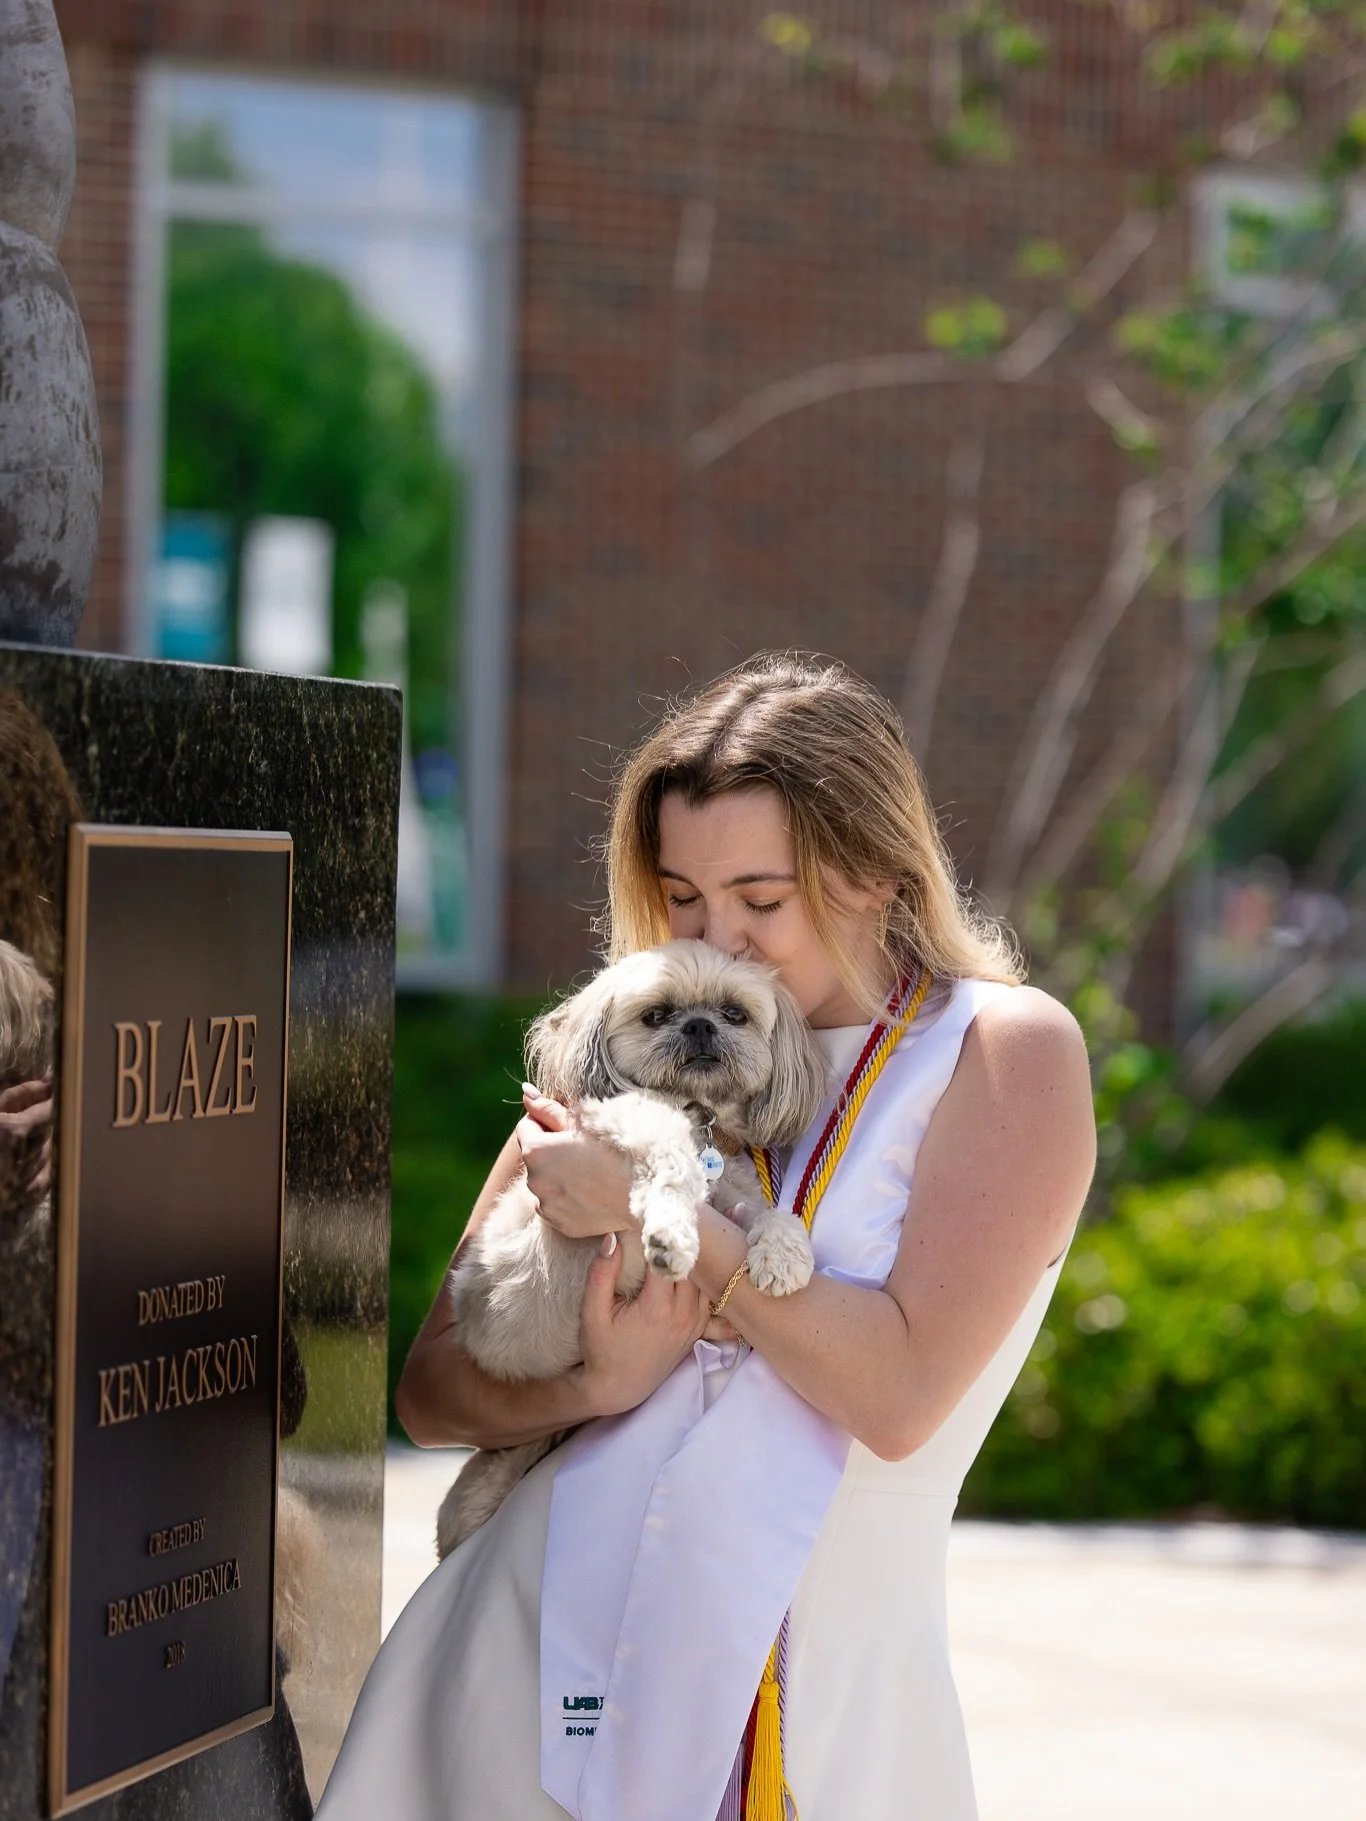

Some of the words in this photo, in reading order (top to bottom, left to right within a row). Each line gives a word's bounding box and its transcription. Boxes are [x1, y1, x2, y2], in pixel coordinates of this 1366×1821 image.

[112, 1014, 258, 1128] BLAZE
[137, 1279, 205, 1326] DONATED
[206, 1275, 226, 1312] BY
[98, 1359, 150, 1427] KEN
[154, 1334, 258, 1412] JACKSON
[150, 1523, 192, 1557] CREATED
[193, 1518, 207, 1543] BY
[107, 1584, 169, 1637] BRANKO
[171, 1560, 242, 1615] MEDENICA
[563, 1696, 599, 1710] UAB
[565, 1726, 597, 1736] BIOM
